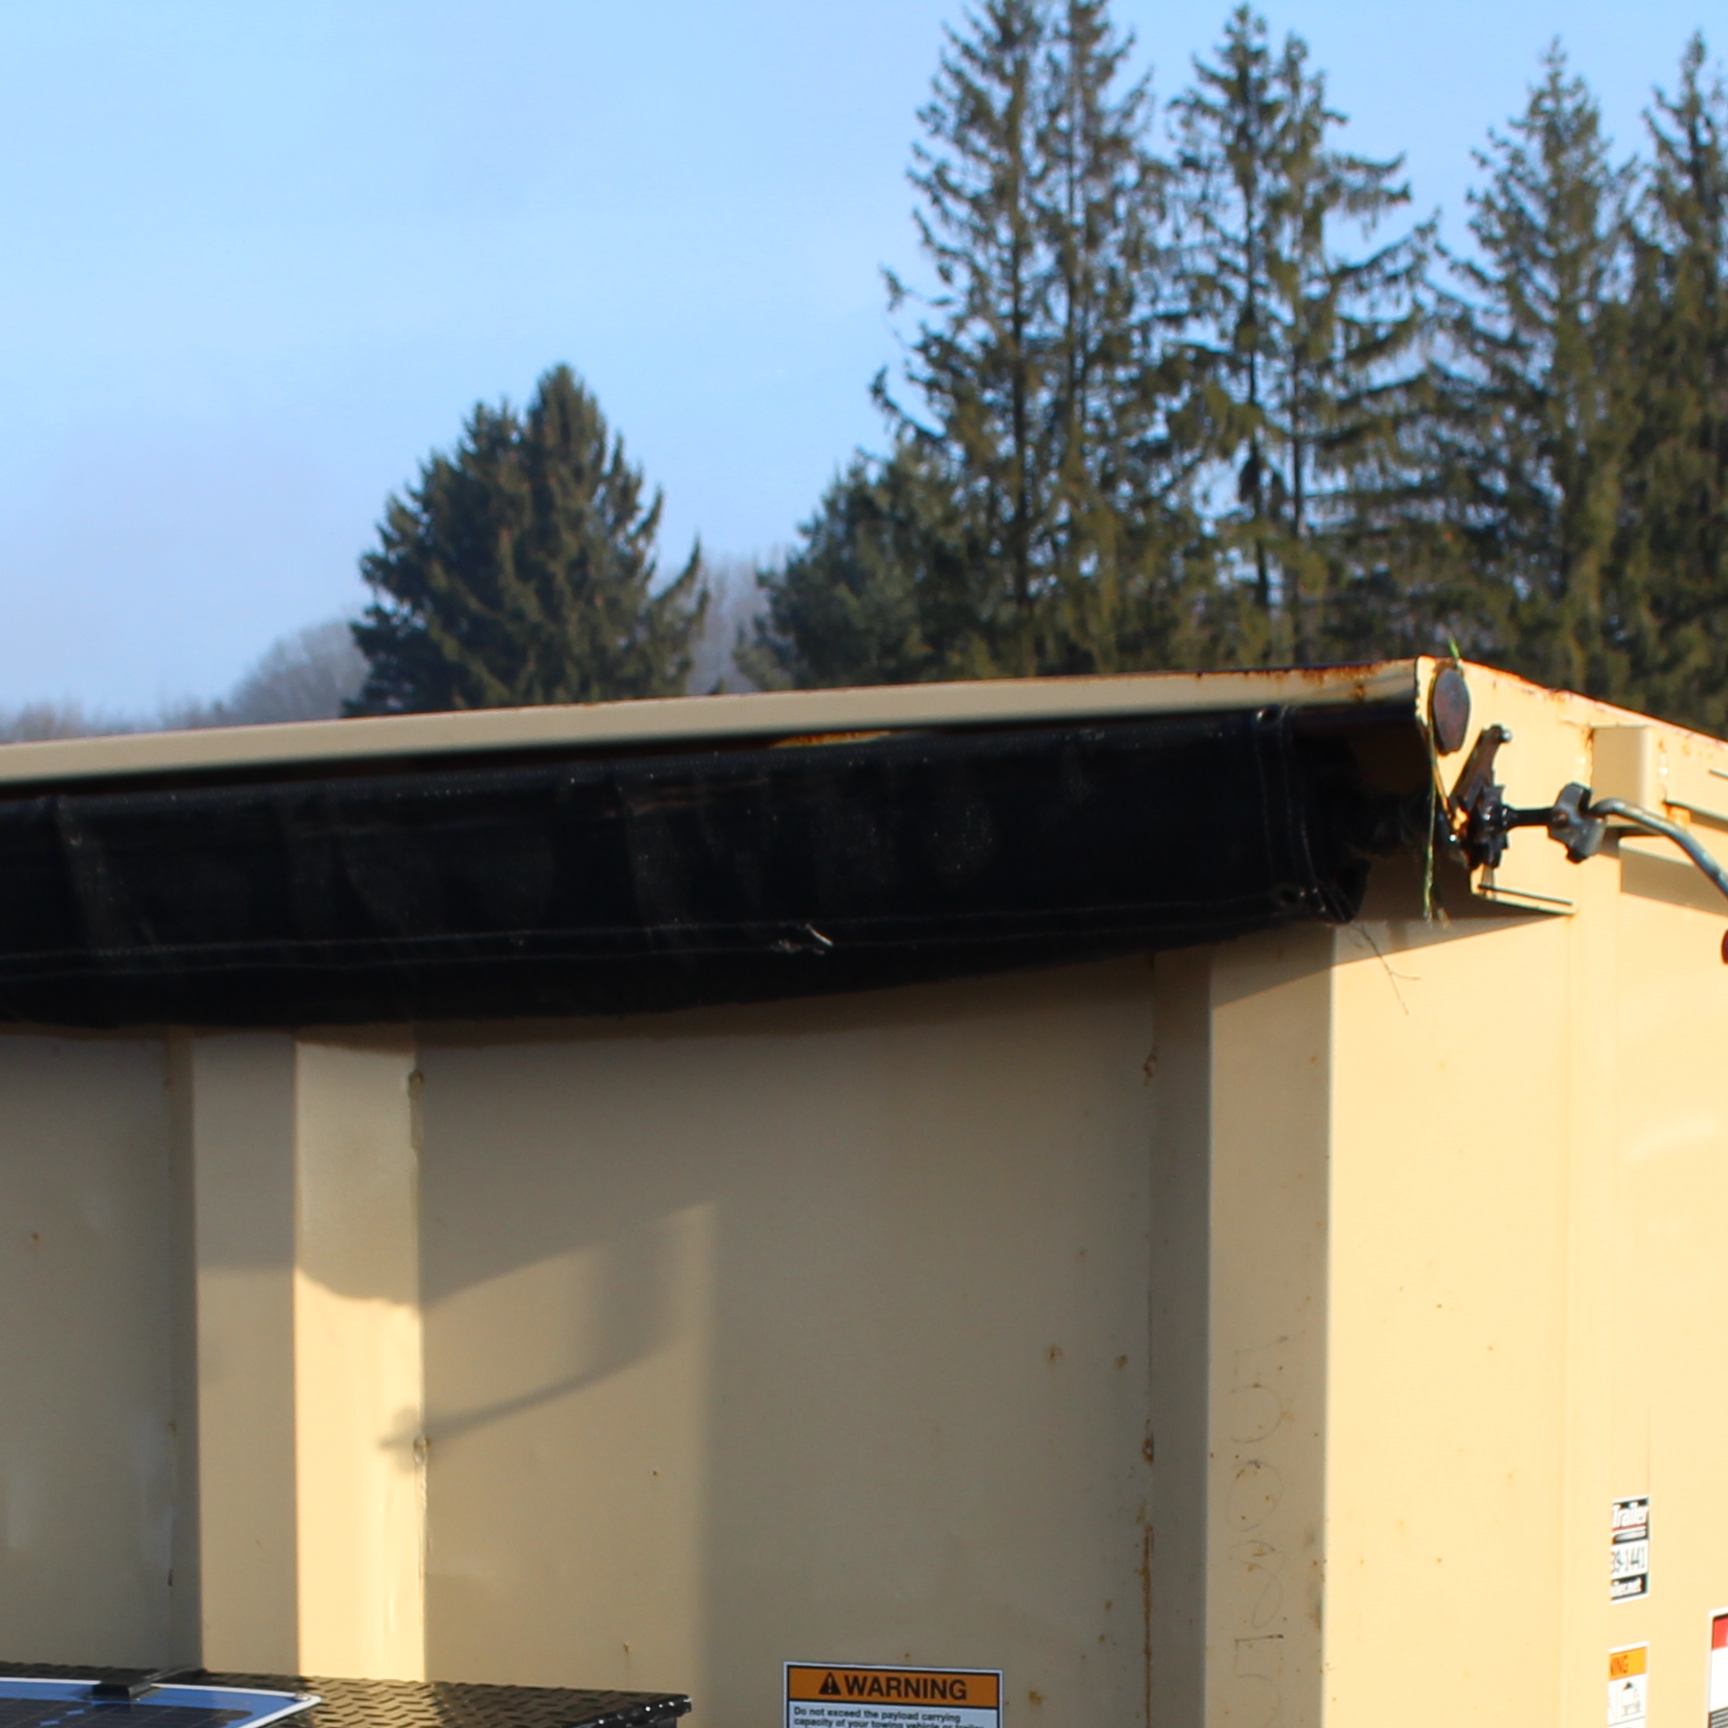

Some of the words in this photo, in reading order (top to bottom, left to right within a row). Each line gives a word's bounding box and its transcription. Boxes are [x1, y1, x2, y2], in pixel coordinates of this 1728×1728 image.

[844, 1675, 967, 1700] WARNING
[795, 1707, 807, 1716] Do
[810, 1708, 824, 1716] not
[828, 1709, 861, 1718] exceed
[864, 1710, 878, 1718] the
[882, 1711, 919, 1721] payload
[922, 1713, 960, 1724] carrying
[795, 1718, 833, 1727] capacity
[837, 1719, 846, 1727] of
[848, 1721, 868, 1728] your
